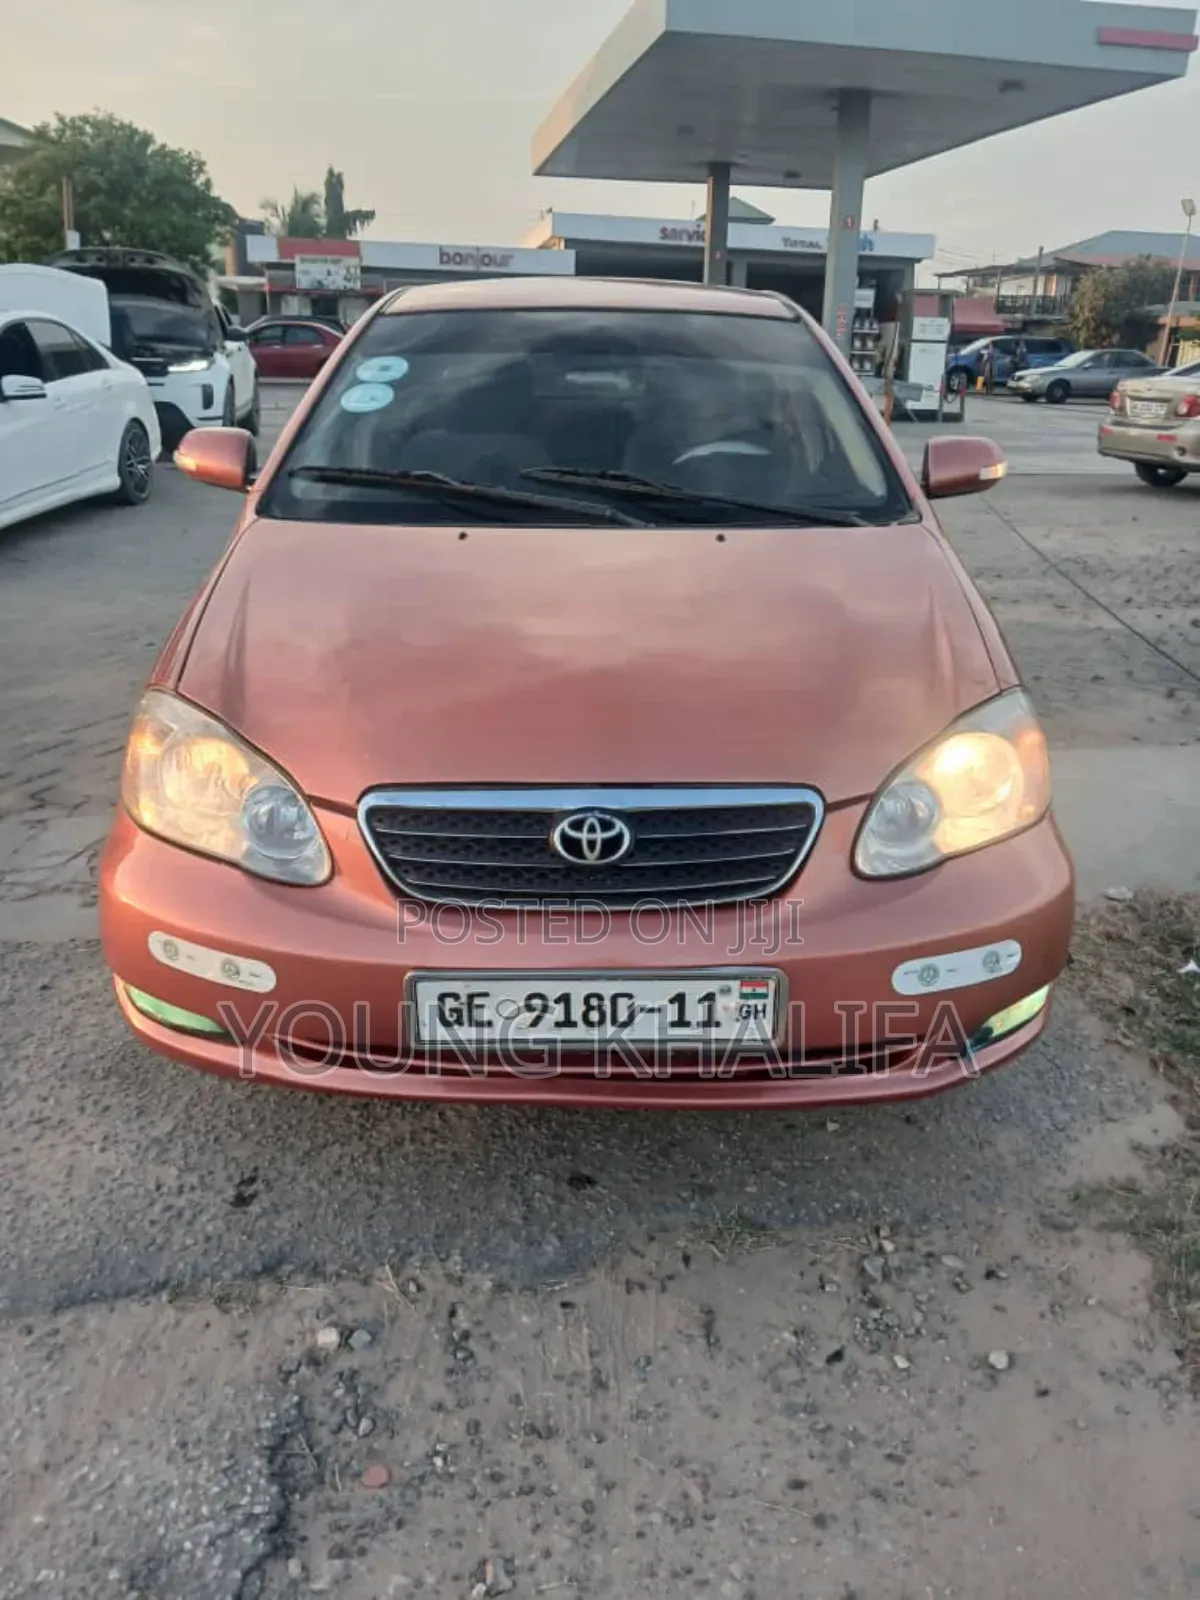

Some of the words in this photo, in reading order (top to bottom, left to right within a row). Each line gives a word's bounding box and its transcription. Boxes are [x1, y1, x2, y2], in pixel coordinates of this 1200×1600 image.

[438, 245, 515, 271] bonjour
[436, 992, 492, 1029] GE
[523, 991, 721, 1028] 9180-11
[740, 1003, 766, 1020] GH
